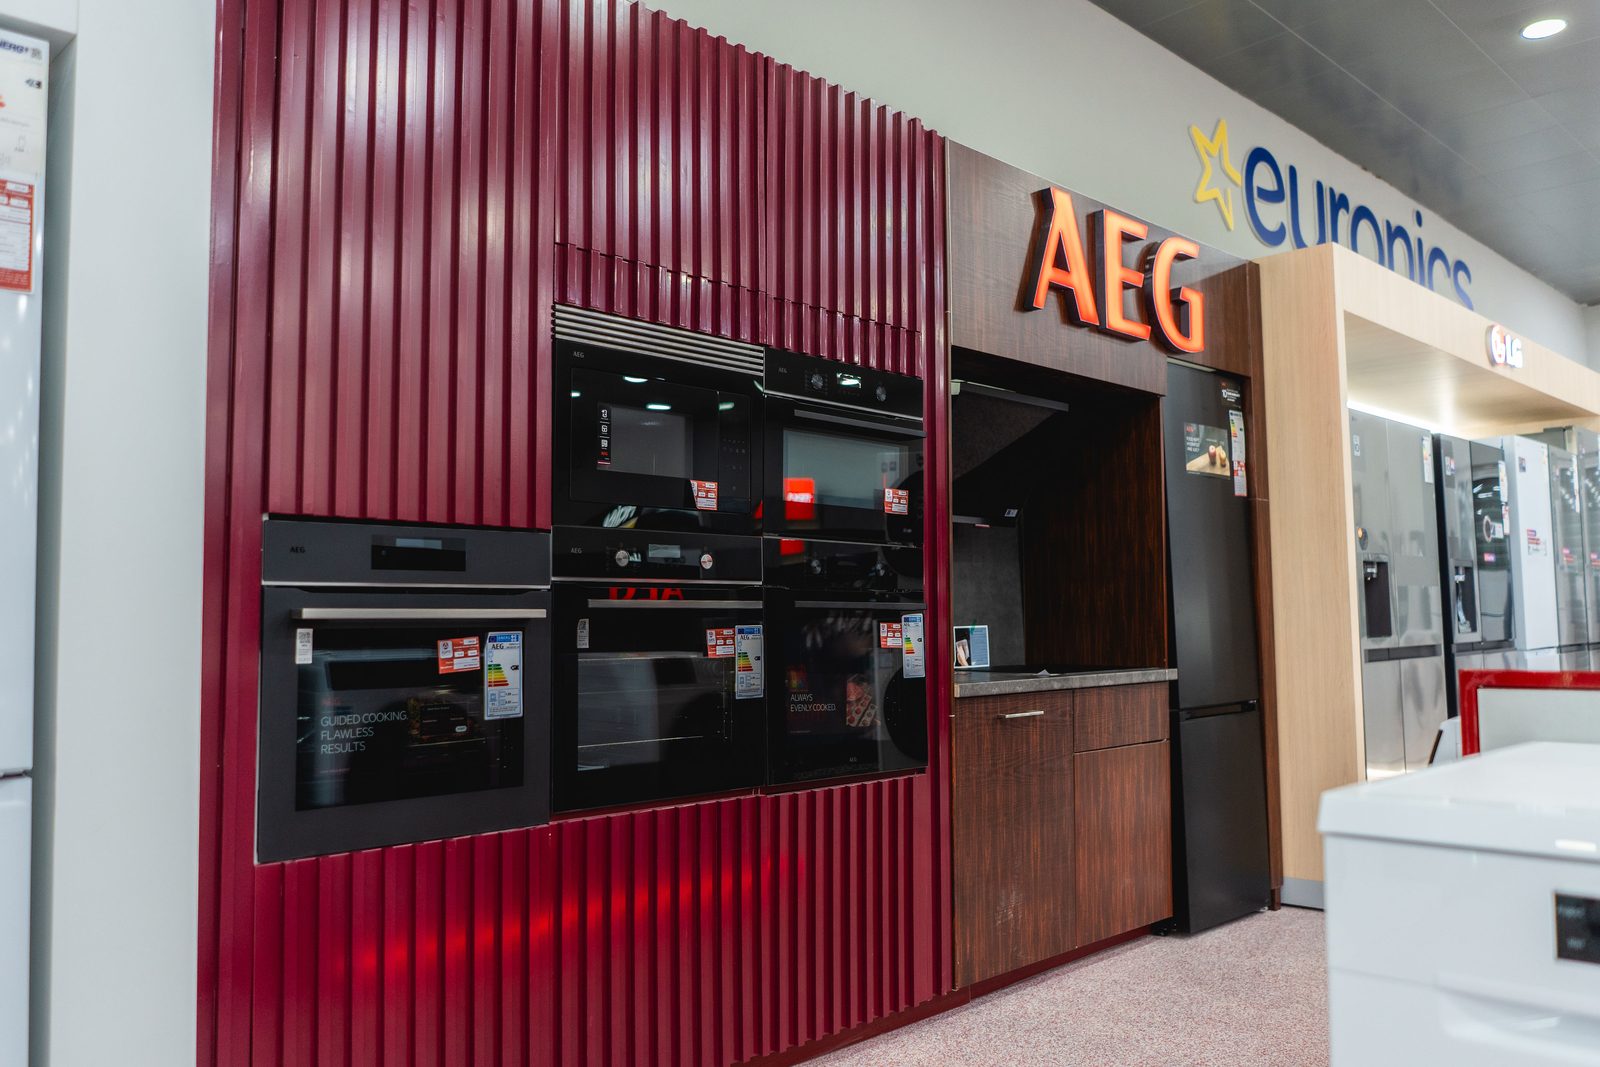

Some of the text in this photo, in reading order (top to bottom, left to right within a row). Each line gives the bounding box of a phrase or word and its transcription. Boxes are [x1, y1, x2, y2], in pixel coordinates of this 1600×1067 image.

[1244, 146, 1474, 311] euronics
[1026, 186, 1205, 354] AEG
[572, 351, 585, 359] AEG
[290, 546, 306, 554] AEG
[790, 693, 813, 702] ALWAYS
[790, 704, 812, 712] EVENLY
[320, 710, 409, 728] GUIDED COOKING.
[320, 726, 375, 741] FLAWLESS
[320, 741, 367, 755] RESULTS
